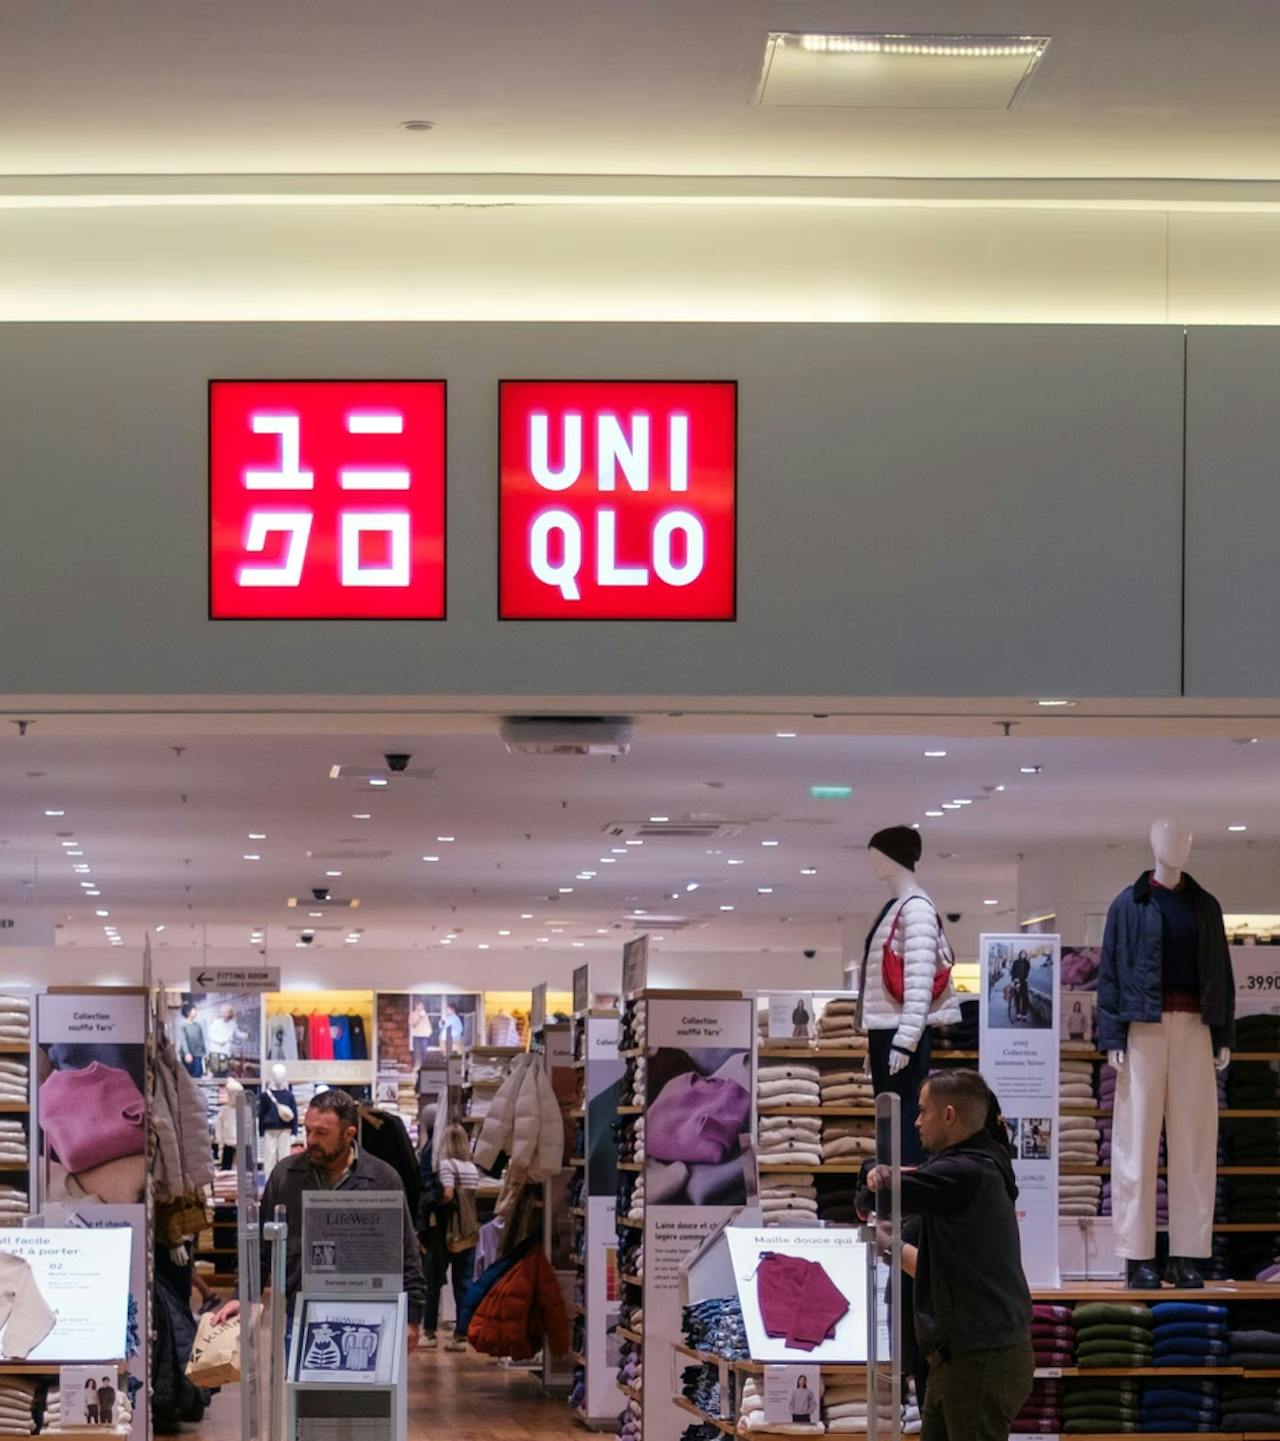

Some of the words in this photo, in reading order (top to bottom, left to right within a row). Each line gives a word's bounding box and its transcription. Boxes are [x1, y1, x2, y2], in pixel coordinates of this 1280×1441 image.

[245, 416, 410, 490] ユニ
[530, 415, 688, 491] UNI
[238, 513, 410, 587] クロ
[530, 510, 704, 600] QLO
[73, 1012, 110, 1020] Collection
[682, 1017, 718, 1025] Collection
[326, 1212, 382, 1225] LifeWear
[677, 1221, 698, 1229] douce
[700, 1221, 707, 1229] et
[15, 1235, 51, 1245] facile
[794, 1236, 830, 1244] douce
[834, 1236, 852, 1245] qui
[28, 1246, 36, 1255] à
